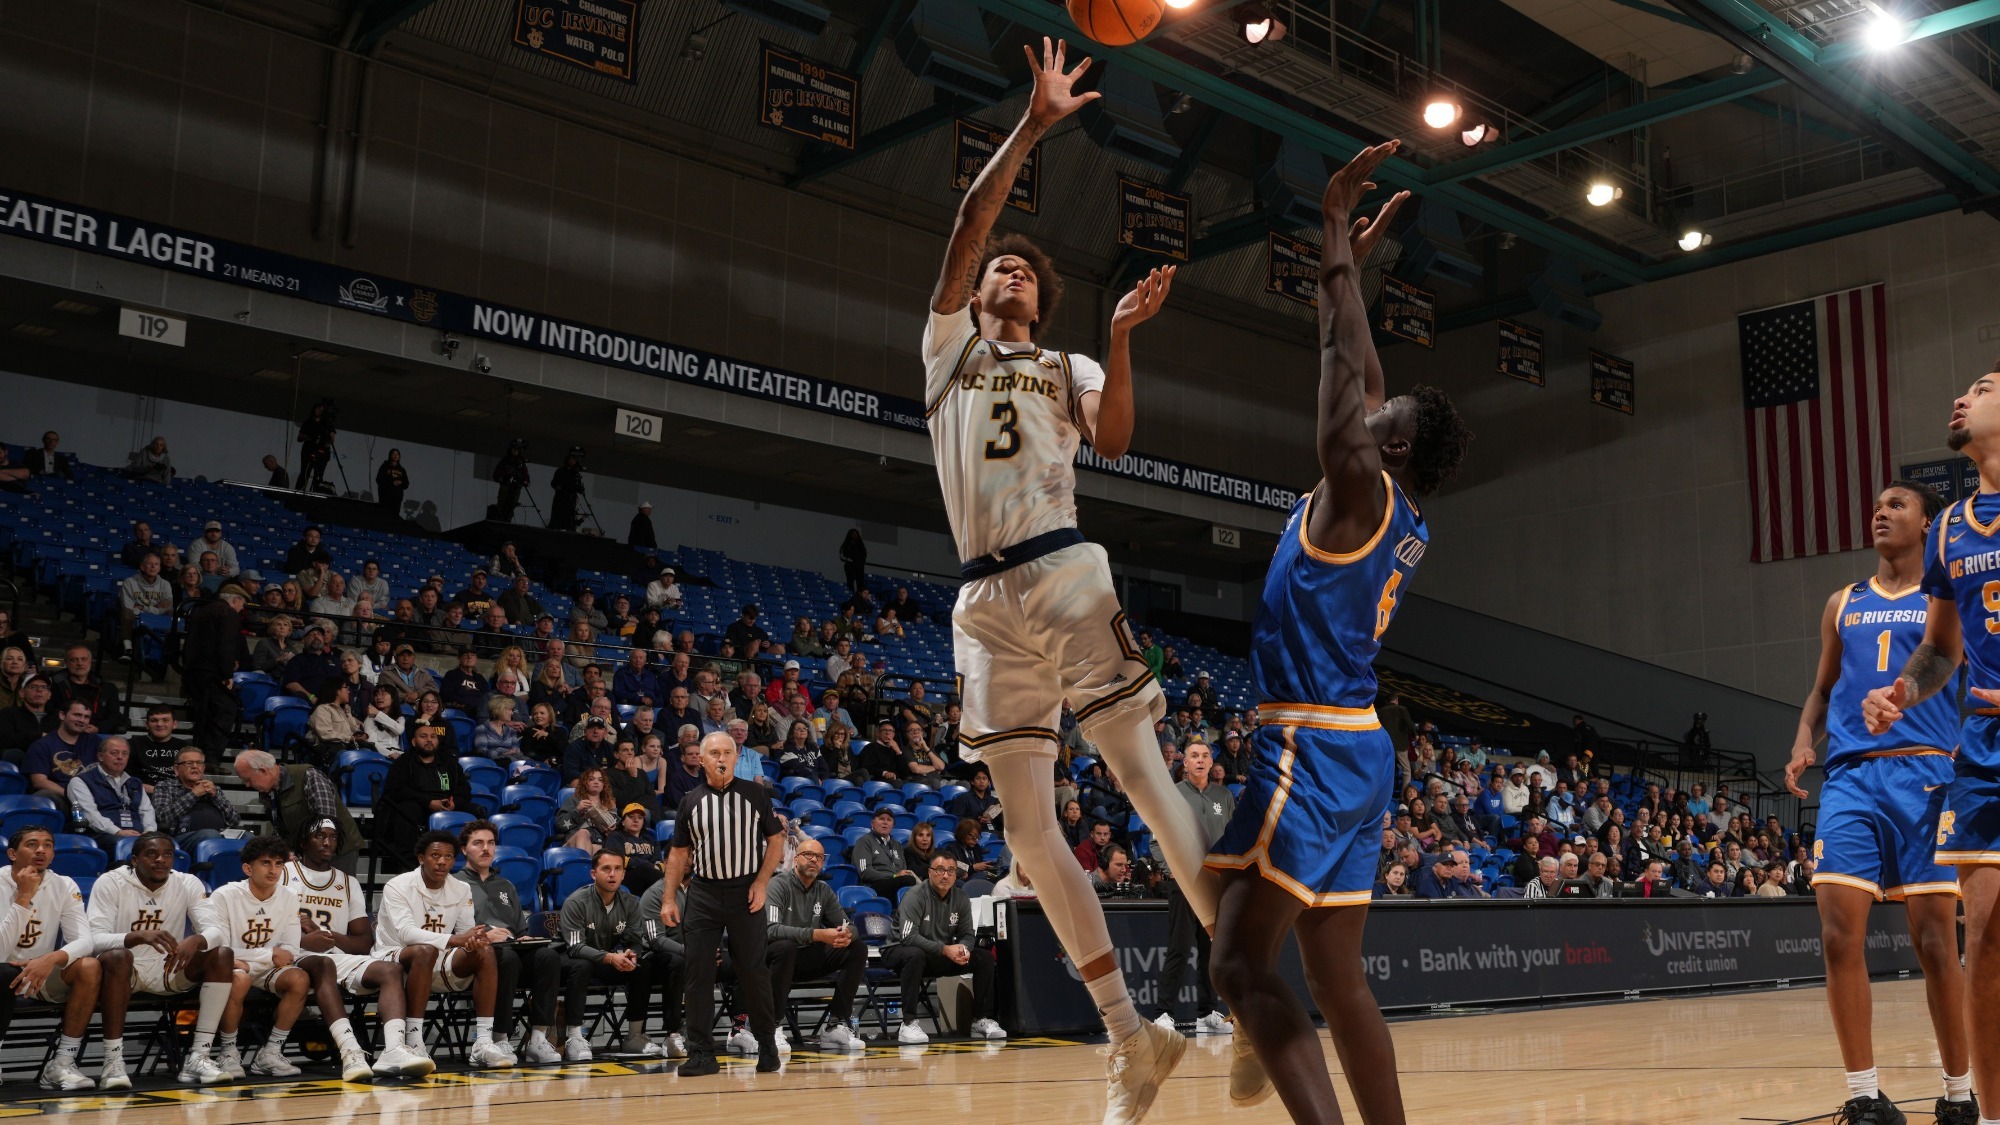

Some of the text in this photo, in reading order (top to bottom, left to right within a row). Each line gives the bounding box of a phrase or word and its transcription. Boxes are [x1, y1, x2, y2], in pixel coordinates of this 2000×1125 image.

[525, 5, 627, 43] UC IRVINE
[565, 33, 625, 63] WATER POLO
[800, 61, 826, 81] 1990
[770, 64, 851, 101] NATIONAL CHAMPIONS
[769, 88, 851, 117] UC IRVINE
[811, 114, 850, 135] SAILING
[962, 134, 994, 153] NATIONAL
[988, 131, 1007, 145] 199
[962, 156, 982, 173] UC
[107, 220, 216, 273] LAGER
[1153, 232, 1184, 249] SAILING
[223, 263, 301, 292] 21 MEANS 21
[138, 314, 169, 339] 119
[473, 303, 880, 420] NOW INTRODUCING ANTEATER LAGER
[961, 371, 1058, 401] UC IRVINE
[625, 414, 653, 437] 120
[893, 412, 921, 428] MEANS
[984, 399, 1021, 462] 3
[1911, 464, 1947, 477] UC IRVINE
[1181, 467, 1252, 502] ANTEATER
[1254, 483, 1297, 510] LAGER
[716, 514, 733, 525] EXIT
[1217, 528, 1235, 545] 122
[1950, 558, 1964, 580] UC
[1844, 609, 1928, 628] UC RIVERSID
[1876, 629, 1892, 672] 1
[305, 895, 343, 908] IRVINE
[1648, 928, 1752, 957] UNIVERSITY
[1775, 937, 1821, 957] ucu.org
[1866, 930, 1912, 952] with you
[1419, 941, 1612, 973] Bank with your brain.
[1667, 954, 1738, 975] credit union
